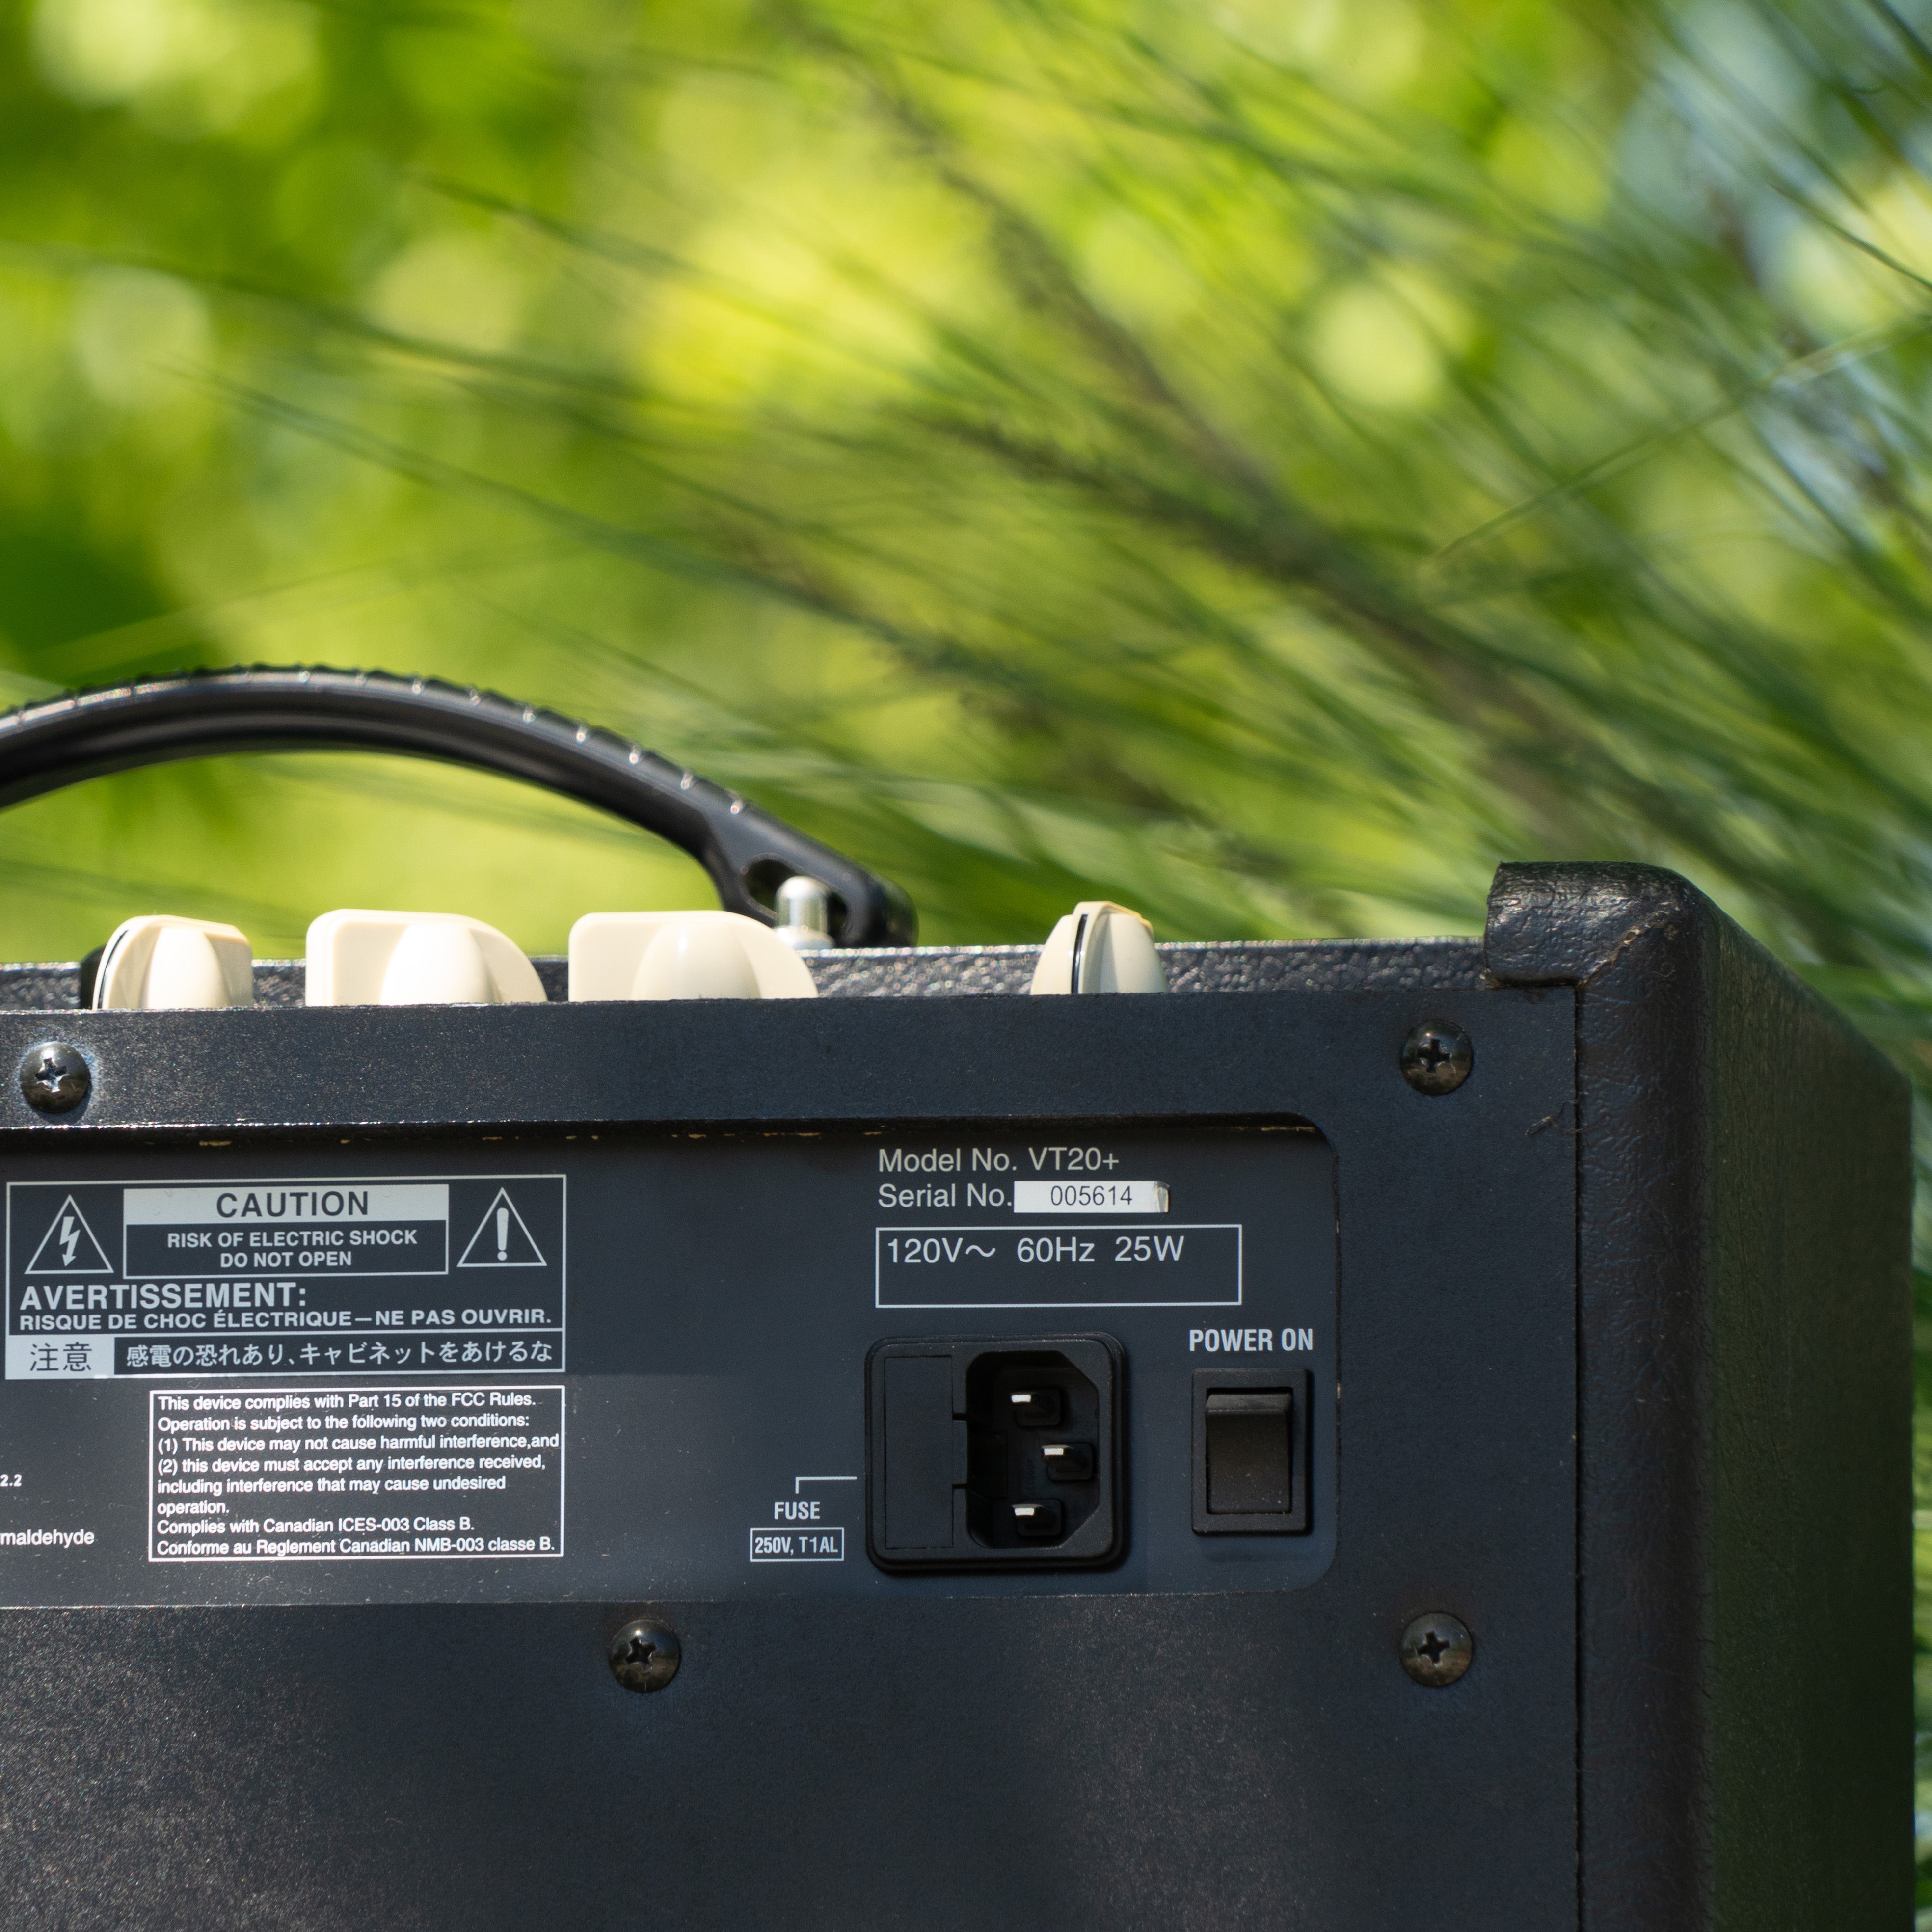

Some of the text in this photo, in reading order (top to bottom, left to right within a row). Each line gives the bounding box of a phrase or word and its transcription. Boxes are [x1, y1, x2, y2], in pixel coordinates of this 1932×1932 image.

[879, 1147, 1119, 1172] Model No. VT20+
[216, 1191, 368, 1218] CAUTION
[878, 1183, 1133, 1208] Serial No. 005614
[167, 1229, 417, 1248] RISK OF ELECTRIC SHOCK
[1017, 1236, 1095, 1263] 60Hz
[1115, 1235, 1184, 1261] 25W
[220, 1251, 351, 1268] DO NOT OPEN
[20, 1282, 306, 1310] AVERTISSEMENT:
[20, 1314, 102, 1330] RISQUE
[108, 1314, 137, 1329] DE
[144, 1313, 206, 1329] CHOC
[411, 1309, 456, 1325] PAS
[461, 1308, 551, 1325] OUVRIR.
[1189, 1328, 1313, 1352] POWER ON
[30, 1342, 92, 1372] 注意
[126, 1340, 552, 1368] 感電の恐れあり、キャビネットをあけるな
[157, 1392, 536, 1412] This device complies with Part 15 of the FCC Rules.
[158, 1413, 529, 1435] Operation is subject to the following two conditions:
[158, 1438, 178, 1455] (1)
[182, 1437, 214, 1452] This
[217, 1437, 266, 1451] device
[269, 1439, 301, 1454] may
[305, 1436, 328, 1450] not
[331, 1438, 376, 1450] cause
[380, 1434, 436, 1449] harmful
[158, 1454, 545, 1476] (2) this device must accept any interference received,
[157, 1475, 506, 1497] including interference that may cause undesired
[157, 1500, 230, 1517] operation.
[774, 1501, 820, 1520] FUSE
[157, 1516, 475, 1537] Complies with Canadian ICES-003 Class B.
[0, 1529, 95, 1549] maldehyde
[157, 1536, 555, 1556] Conforme au Reglement Canadian NMB-003 classe B.
[755, 1536, 838, 1556] 250V, T1AL
